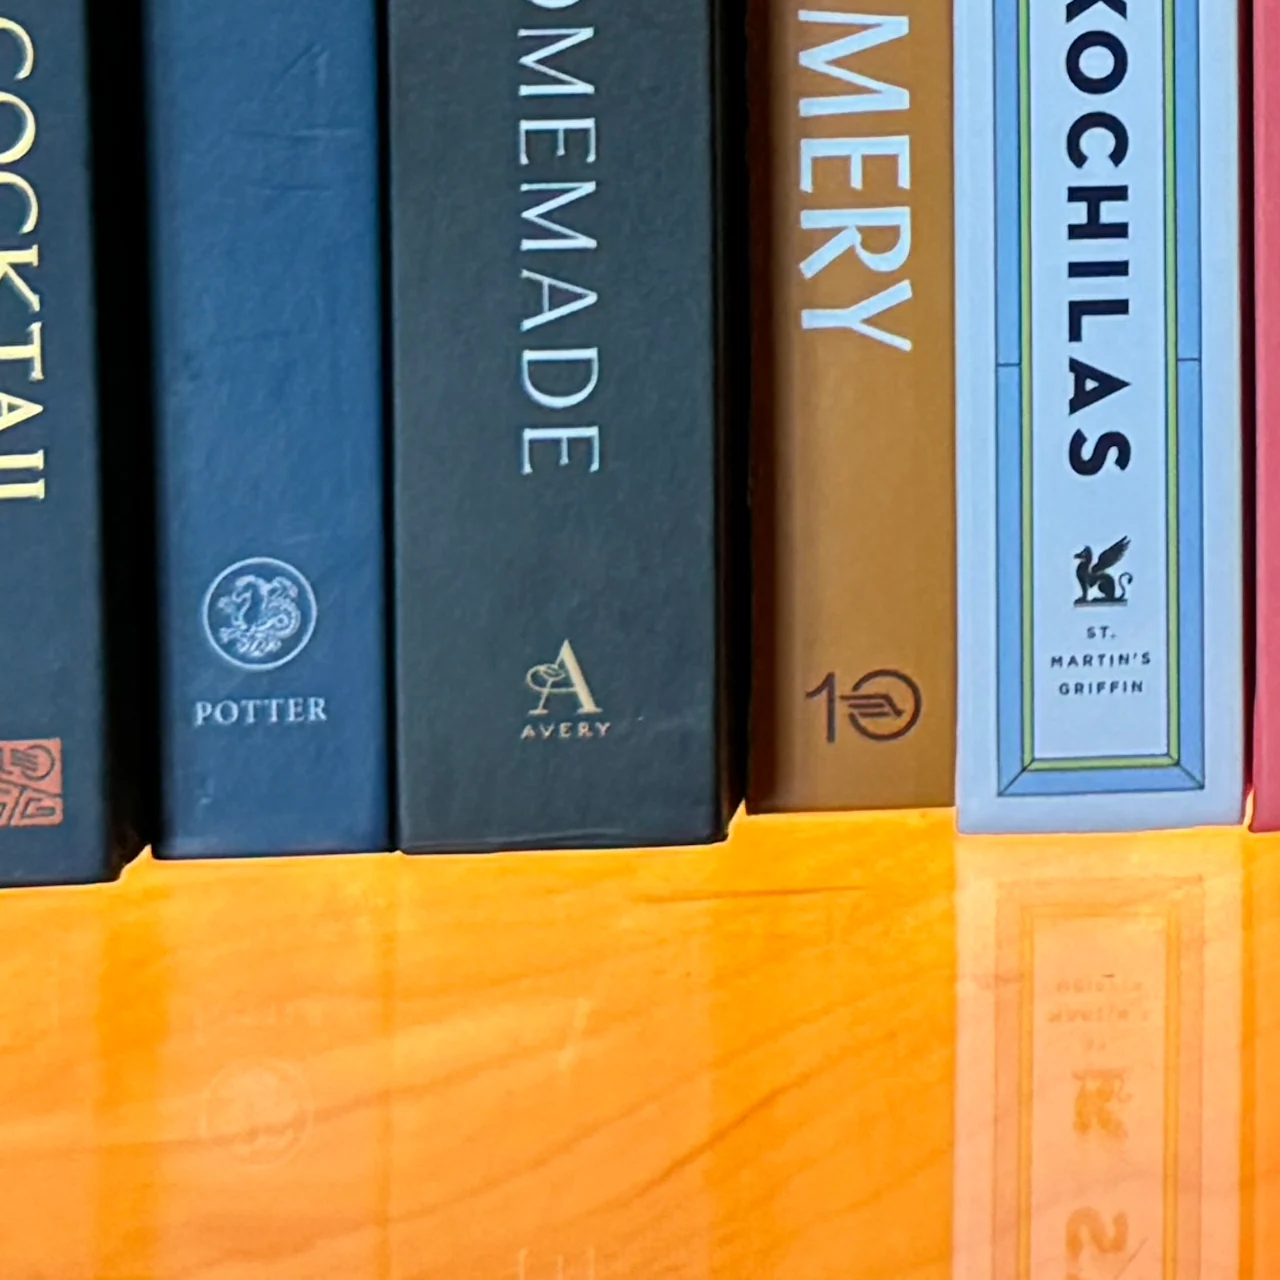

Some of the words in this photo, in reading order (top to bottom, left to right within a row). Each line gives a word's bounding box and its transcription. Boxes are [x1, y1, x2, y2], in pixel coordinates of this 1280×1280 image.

[1086, 626, 1116, 639] ST.
[1050, 651, 1151, 668] MARTIN'S
[1058, 680, 1144, 695] GRIFFIN
[193, 696, 327, 725] POTTER
[519, 721, 612, 740] AVERY
